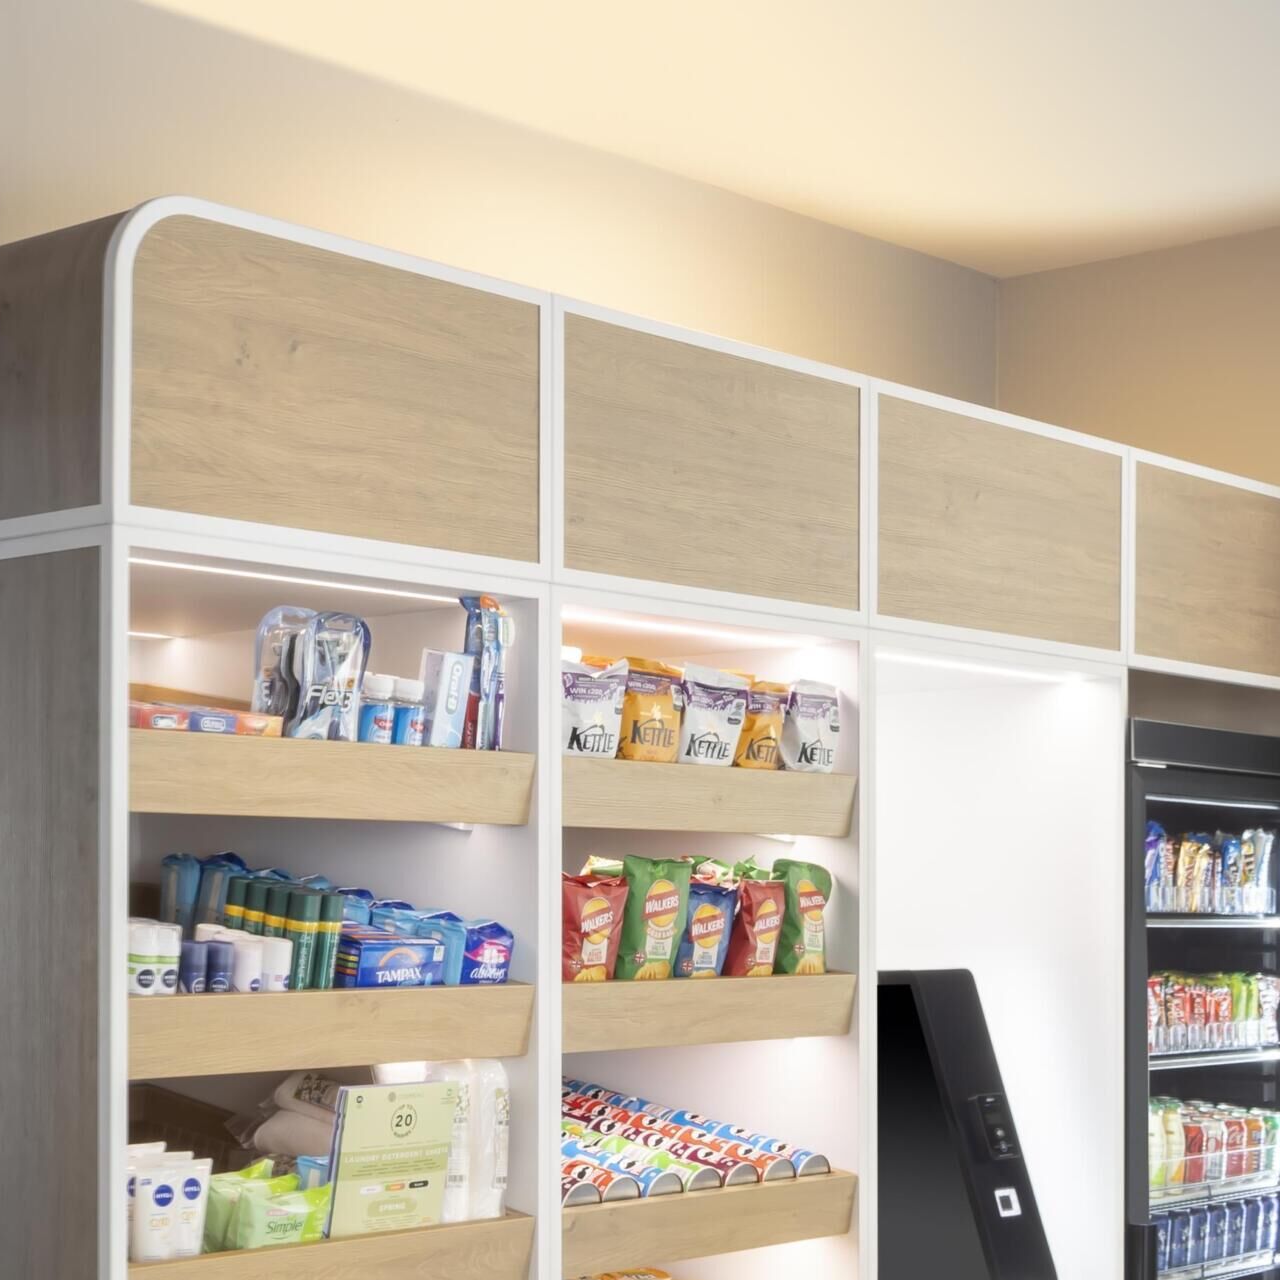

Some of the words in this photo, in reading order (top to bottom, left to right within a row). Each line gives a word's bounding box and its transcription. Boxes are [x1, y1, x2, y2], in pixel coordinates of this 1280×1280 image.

[567, 724, 615, 752] KETTLE
[630, 718, 675, 748] KETTLE
[685, 731, 730, 760] KETTLE
[645, 895, 679, 914] WALKERS
[581, 911, 614, 933] WALKERS
[692, 918, 725, 937] WALKERS
[376, 967, 422, 983] TAMPAX
[395, 1114, 413, 1128] 20
[266, 1220, 303, 1235] Simple
